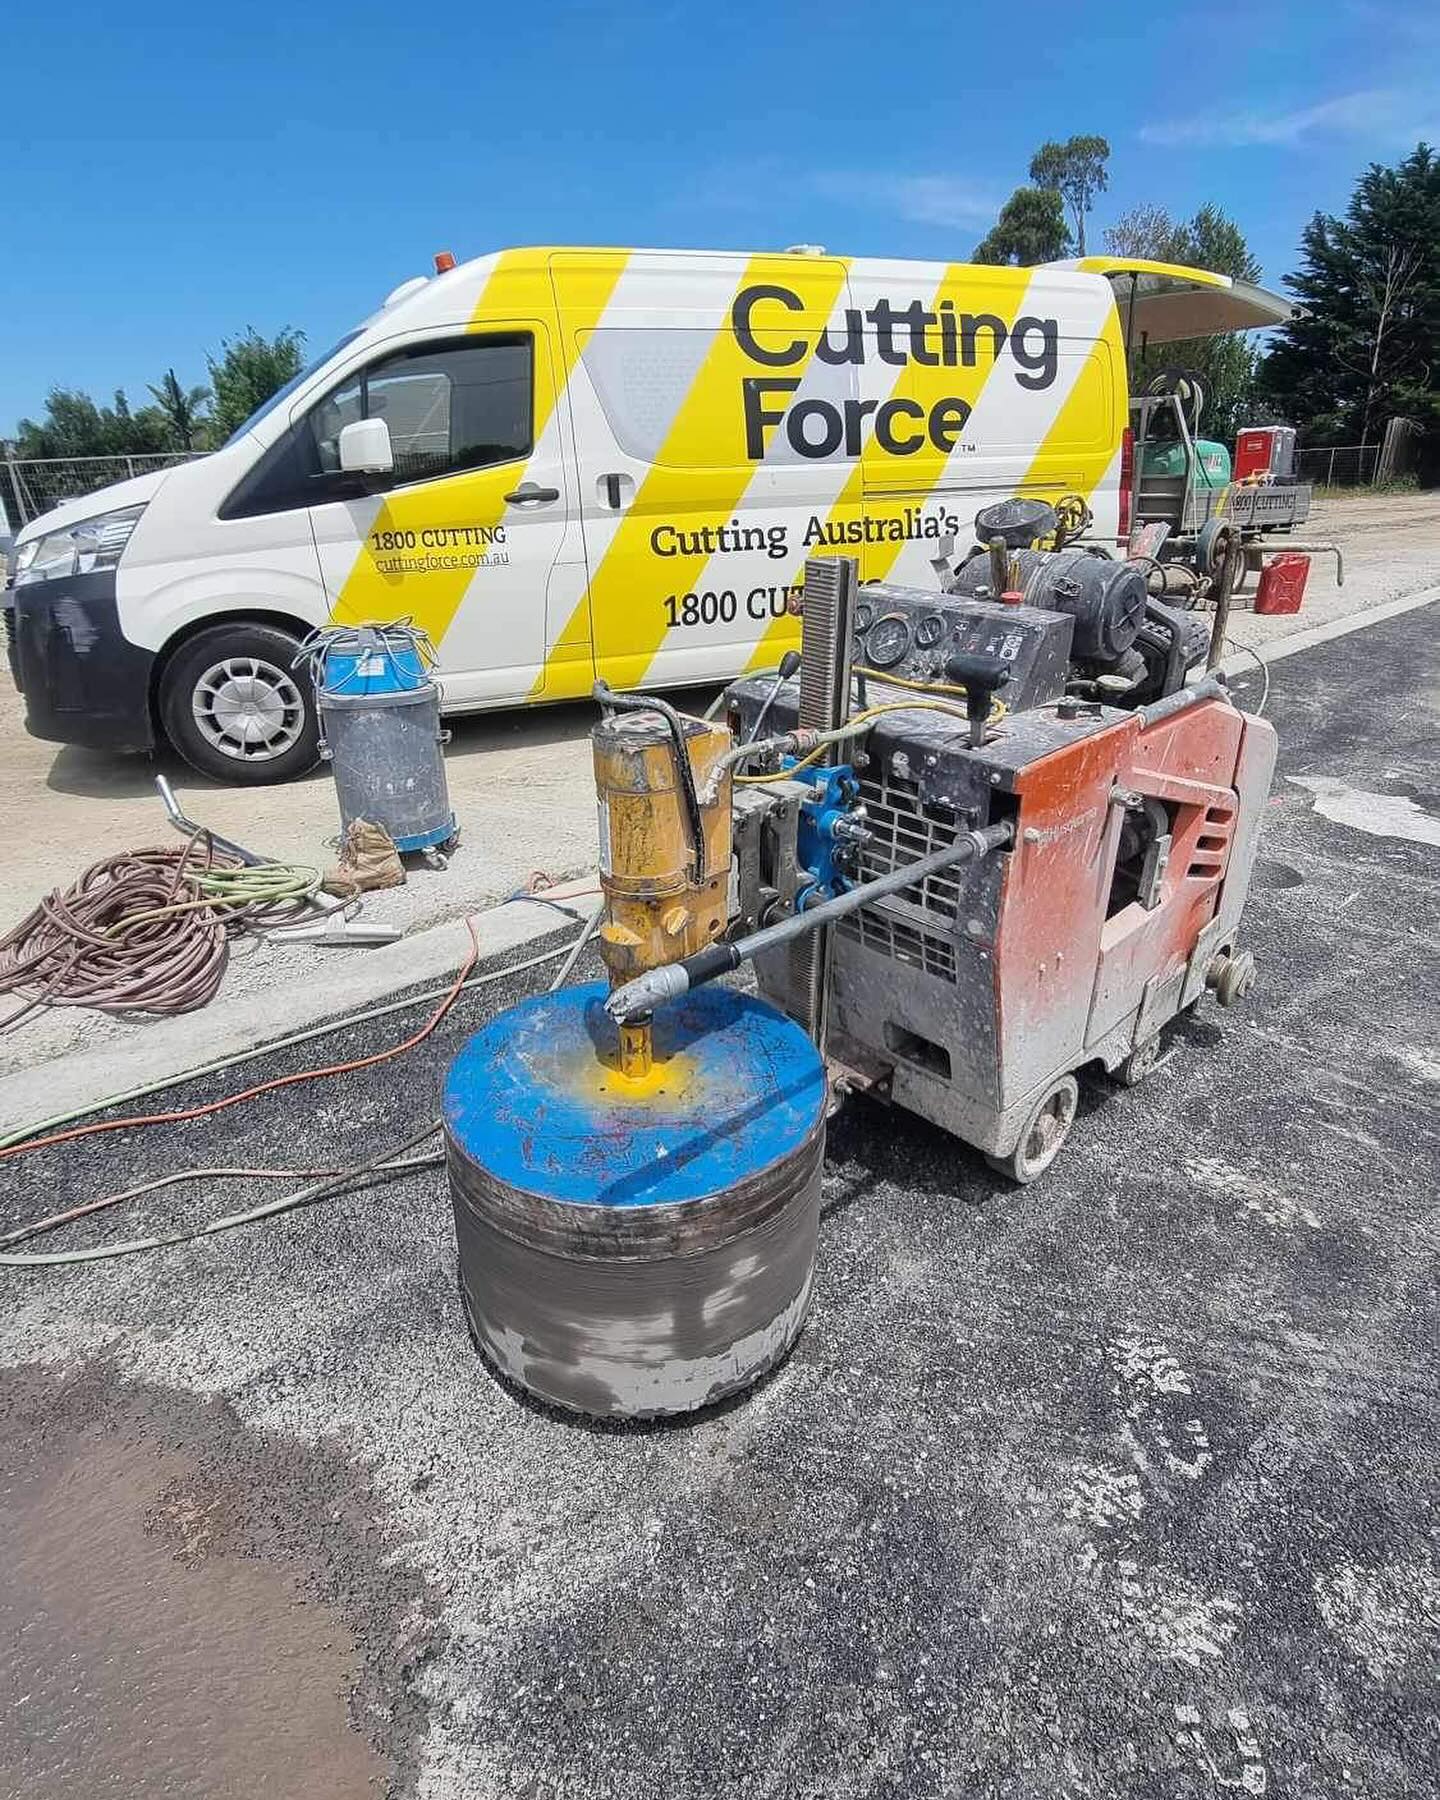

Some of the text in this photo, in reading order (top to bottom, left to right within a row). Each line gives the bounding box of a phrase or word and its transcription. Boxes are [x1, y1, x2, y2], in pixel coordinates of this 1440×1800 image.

[732, 285, 1058, 391] Cutting
[742, 377, 973, 459] Force
[371, 526, 506, 550] 1800 CUTTING
[651, 507, 959, 559] Cutting Australia’s
[376, 552, 510, 573] cuttingforce.com.au
[664, 590, 737, 627] 1800
